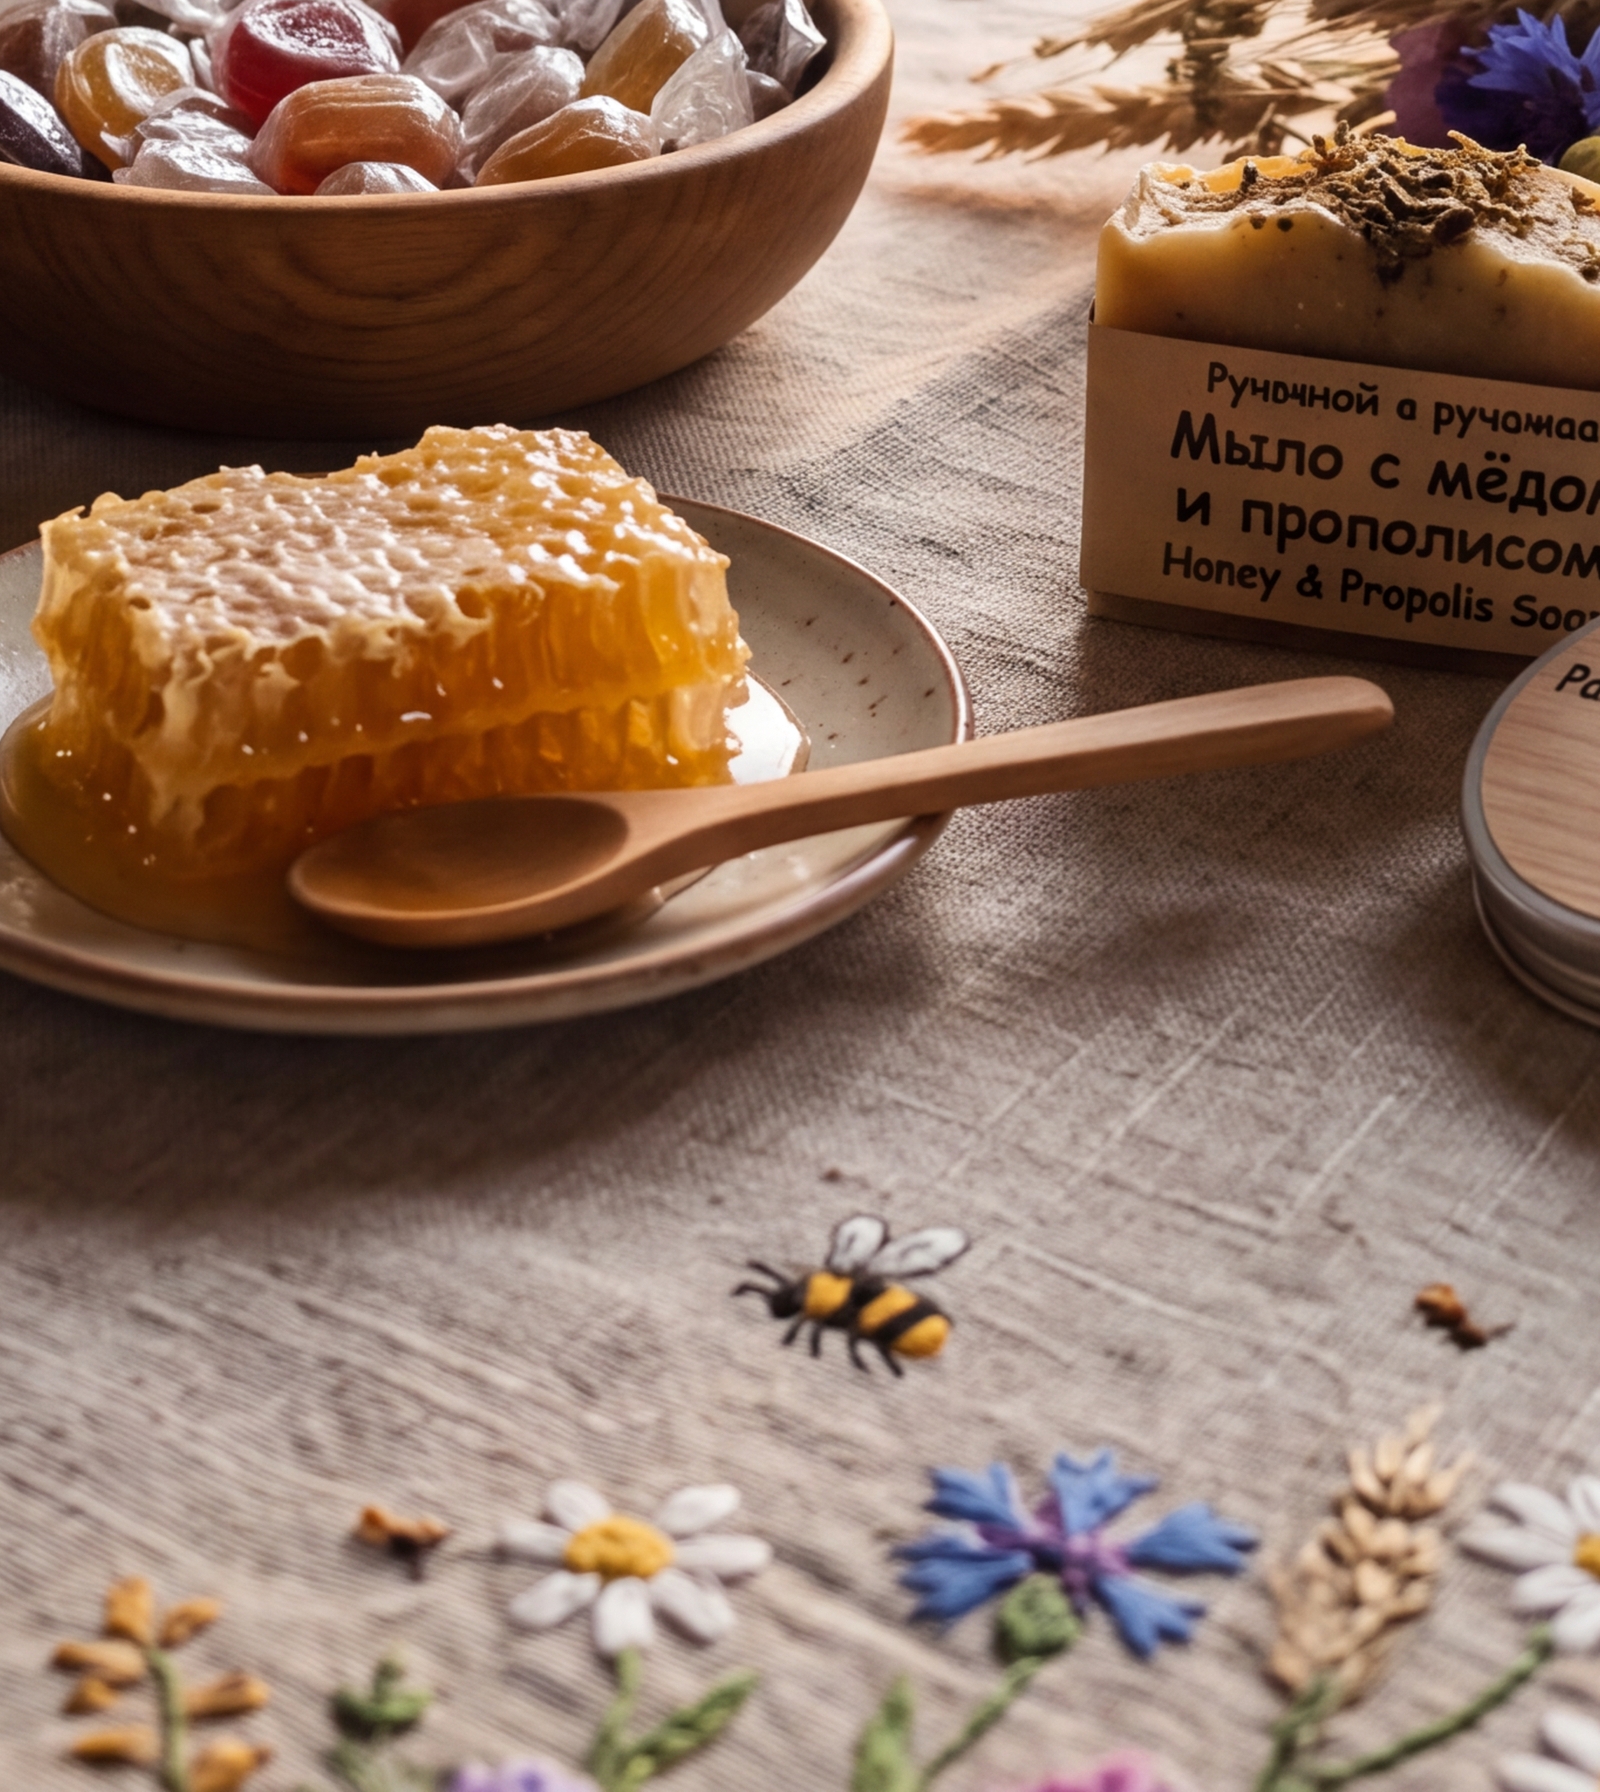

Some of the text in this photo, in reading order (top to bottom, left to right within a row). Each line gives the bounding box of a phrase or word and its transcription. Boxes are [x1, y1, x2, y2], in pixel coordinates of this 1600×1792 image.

[1170, 410, 1343, 480] Мыло
[1370, 451, 1401, 489] с
[1176, 487, 1210, 526] и
[1162, 542, 1281, 601] Honey
[1296, 565, 1323, 599] &
[1341, 569, 1494, 623] Propolis
